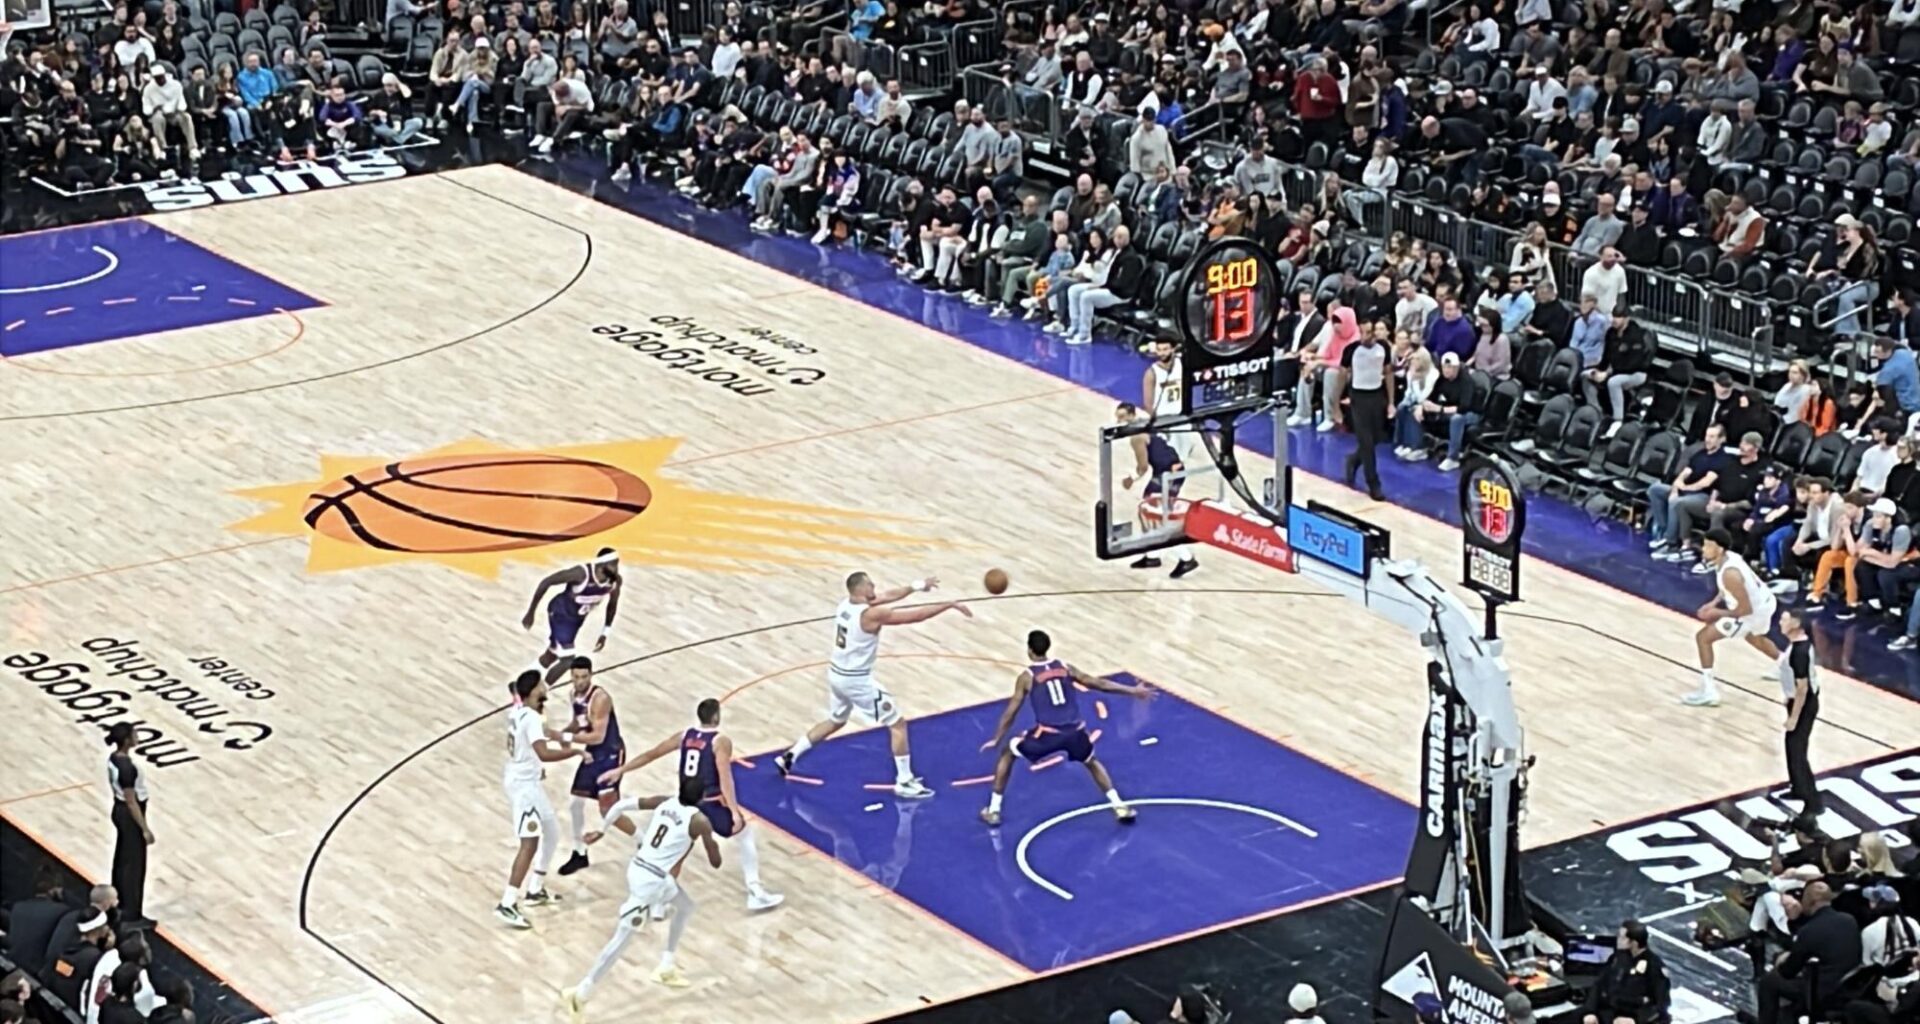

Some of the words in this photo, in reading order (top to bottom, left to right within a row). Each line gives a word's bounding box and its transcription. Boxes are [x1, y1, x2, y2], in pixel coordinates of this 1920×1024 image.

[1208, 258, 1257, 294] 9:00
[1217, 288, 1254, 342] 13
[649, 315, 786, 367] matchup
[592, 324, 775, 396] mortgage
[1213, 356, 1270, 379] TISSOT
[1480, 479, 1512, 511] 9:00
[1485, 504, 1507, 536] 13
[1303, 521, 1349, 557] PayPal
[81, 637, 229, 720] matchup
[188, 656, 275, 700] center
[1046, 679, 1066, 705] 11
[684, 749, 700, 776] 8
[651, 824, 669, 848] 8
[1448, 998, 1505, 1024] AMER
